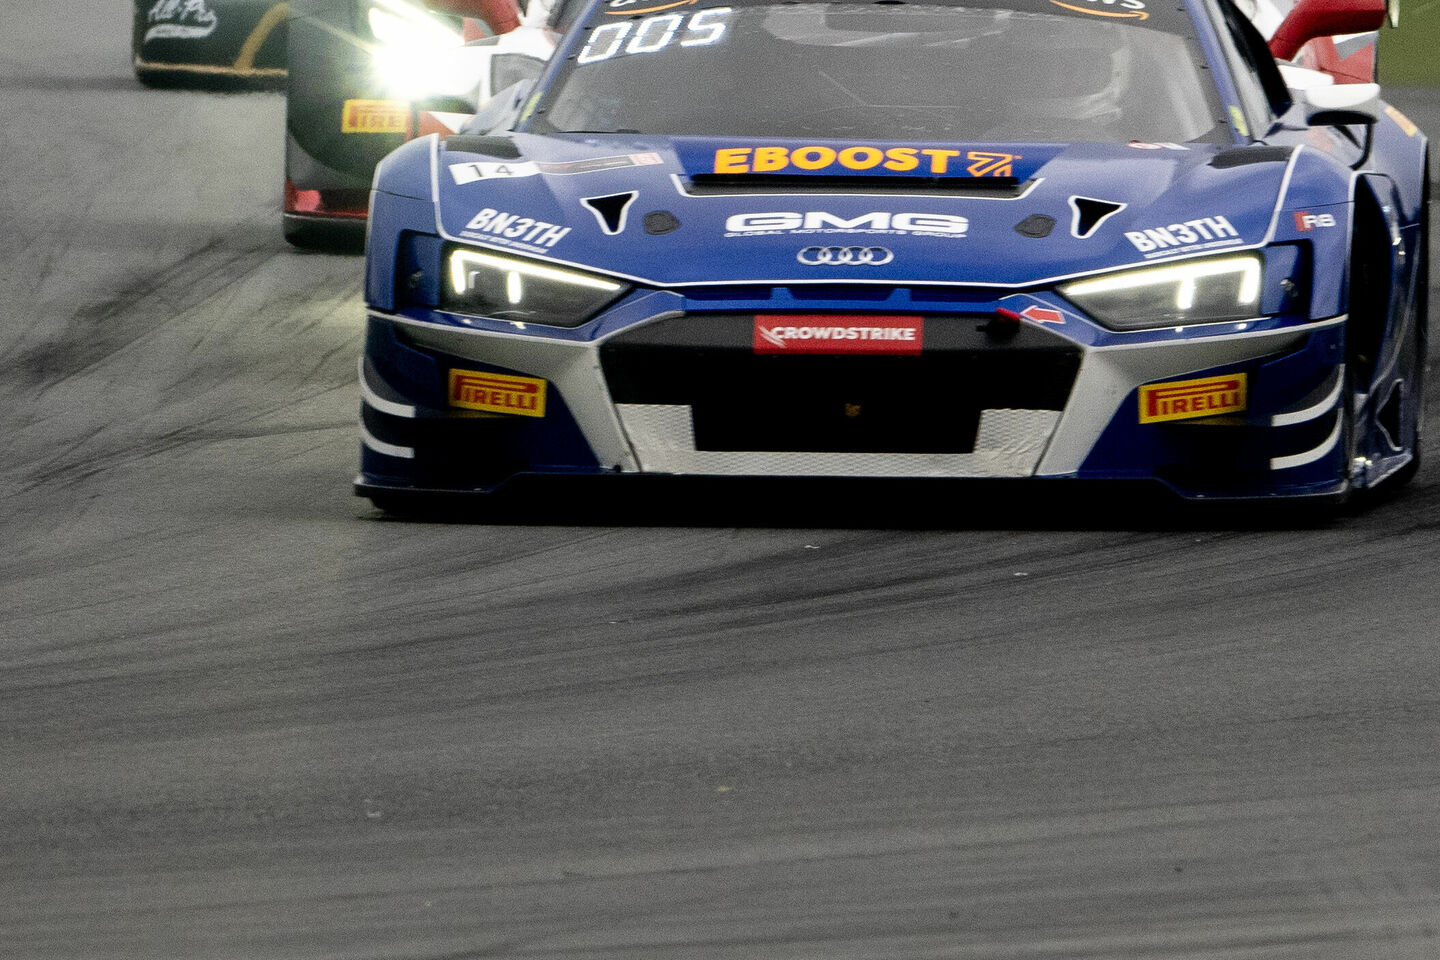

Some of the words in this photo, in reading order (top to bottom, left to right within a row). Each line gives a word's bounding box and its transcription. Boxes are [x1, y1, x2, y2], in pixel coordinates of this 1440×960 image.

[577, 7, 733, 65] 005
[469, 164, 513, 178] 14
[713, 146, 960, 174] EBOOST
[465, 208, 572, 248] BN3TH
[725, 211, 969, 234] GMG
[1124, 215, 1240, 253] BN3TH
[1302, 213, 1337, 229] R8
[770, 326, 917, 341] CROWDSTRIKE
[454, 375, 539, 412] PIRELLI
[1145, 378, 1243, 418] PIRELLI
